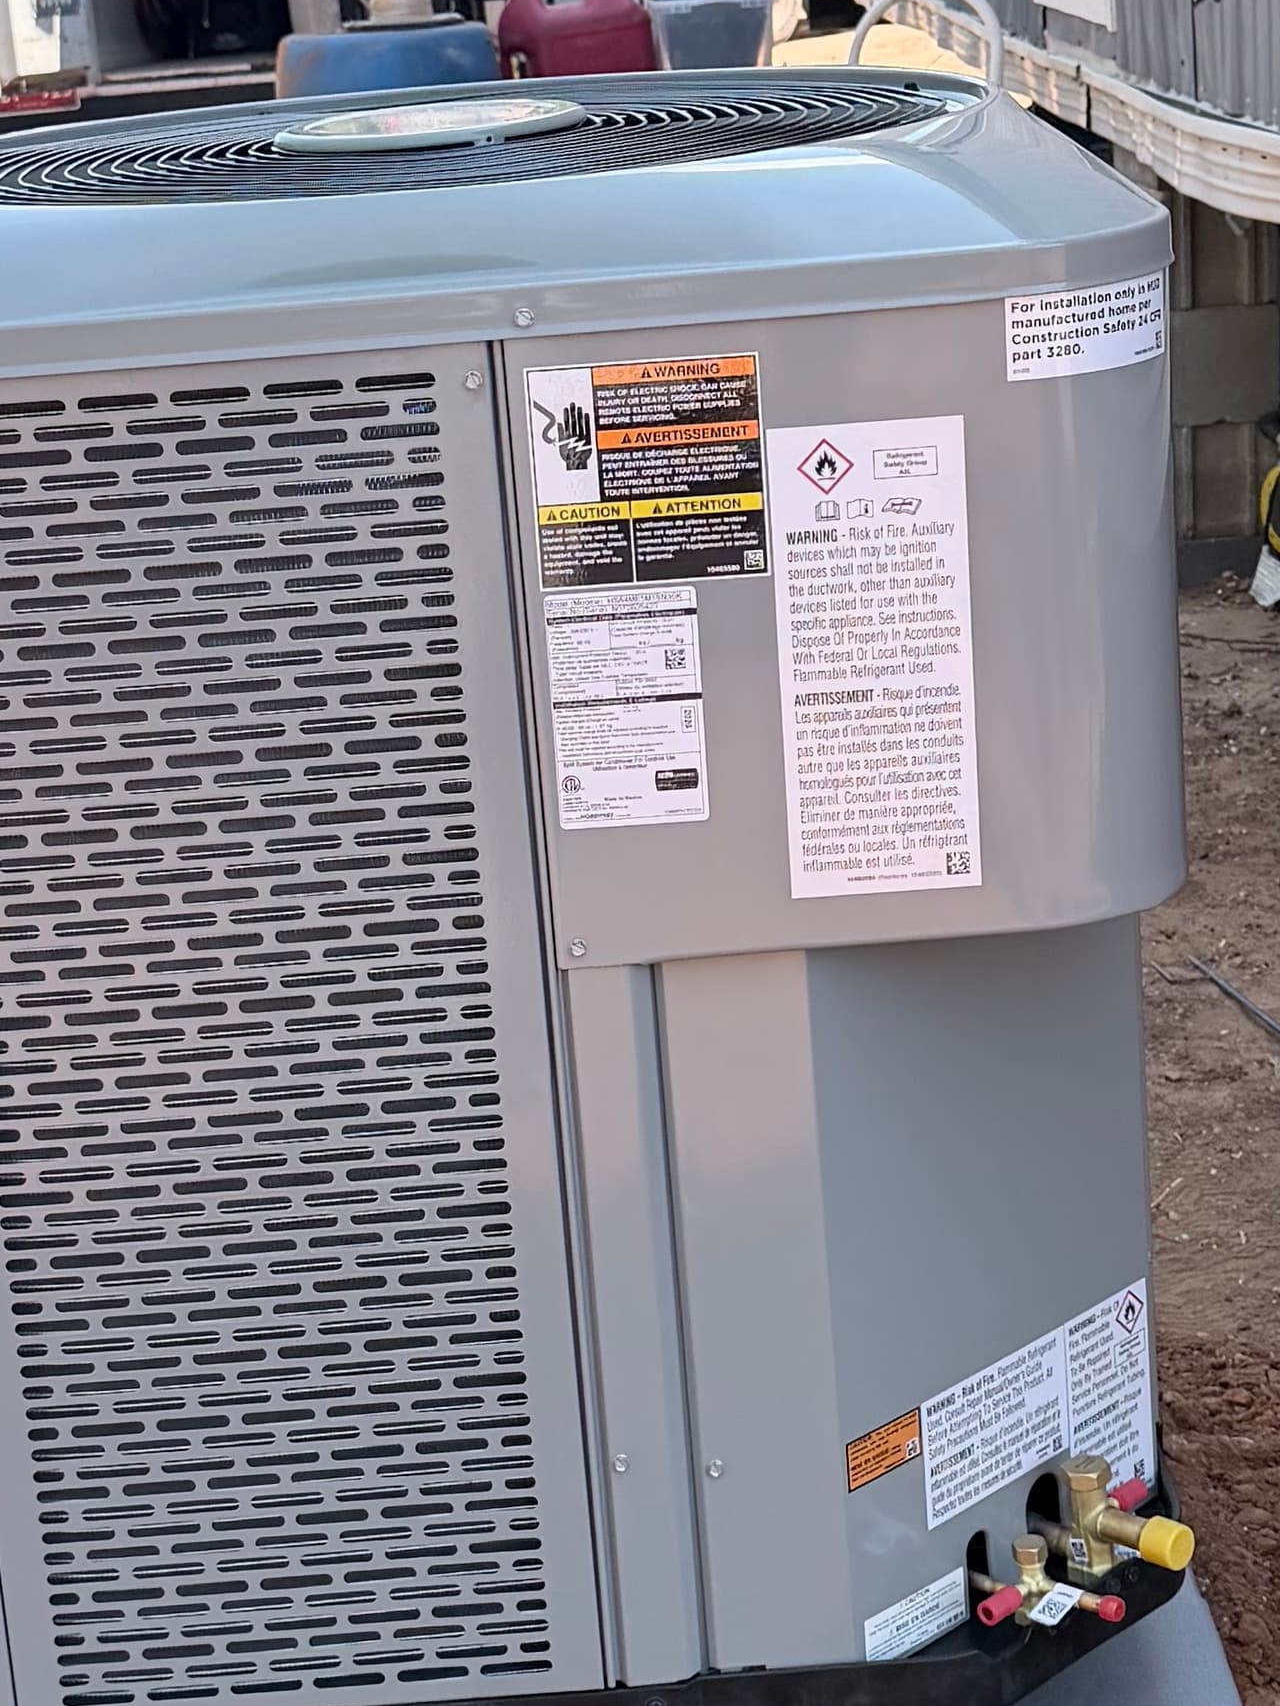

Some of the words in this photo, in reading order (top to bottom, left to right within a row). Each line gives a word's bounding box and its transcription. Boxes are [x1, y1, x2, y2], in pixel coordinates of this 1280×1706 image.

[1011, 302, 1035, 313] For
[1040, 292, 1112, 311] installation
[1115, 287, 1136, 301] only
[1012, 308, 1105, 329] manufactured
[1109, 304, 1136, 317] home
[1138, 299, 1151, 312] per
[1012, 325, 1099, 344] Construction
[1103, 318, 1136, 333] Safety
[1138, 315, 1148, 326] 24
[1013, 347, 1042, 363] part
[1047, 343, 1085, 358] 3280.
[654, 363, 720, 377] WARNING
[630, 386, 668, 395] ELECTRIC
[723, 391, 737, 399] ALL
[633, 405, 671, 414] ELECTRIC
[635, 425, 749, 443] AVERTISSEMENT
[559, 505, 621, 521] CAUTION
[666, 498, 742, 514] ATTENTION
[786, 529, 838, 544] WARNING
[849, 526, 870, 541] Risk
[874, 526, 883, 539] of
[911, 521, 955, 536] Auxiliary
[787, 548, 824, 563] devices
[827, 544, 856, 559] which
[861, 546, 881, 559] may
[885, 543, 896, 556] be
[900, 539, 937, 555] ignition
[788, 567, 827, 580] sources
[830, 563, 854, 577] shall
[857, 562, 873, 575] not
[876, 561, 888, 573] be
[891, 558, 932, 572] installed
[935, 556, 945, 569] in
[789, 584, 804, 597] the
[807, 579, 857, 596] ductwork,
[860, 579, 885, 592] other
[889, 577, 911, 589] than
[914, 573, 956, 588] auxiliary
[790, 600, 827, 614] devices
[830, 597, 856, 611] listed
[860, 597, 873, 609] for
[877, 597, 895, 608] use
[898, 593, 918, 606] with
[921, 591, 938, 604] the
[791, 616, 827, 632] specific
[829, 614, 875, 631] appliance.
[879, 611, 896, 625] See
[898, 608, 956, 623] instructions.
[792, 634, 831, 649] Dispose
[833, 632, 844, 645] Of
[847, 629, 888, 645] Properly
[891, 626, 901, 639] In
[904, 623, 961, 640] Accordance
[792, 651, 815, 665] With
[819, 648, 854, 663] Federal
[857, 647, 868, 660] Or
[872, 644, 898, 659] Local
[901, 641, 962, 660] Regulations.
[793, 666, 847, 682] Flammable
[850, 661, 906, 679] Refrigerant
[794, 689, 874, 707] AVERTISSEMENT
[883, 687, 914, 702] Risque
[795, 710, 811, 724] Les
[813, 707, 853, 725] appareils
[900, 703, 914, 718] qui
[915, 700, 962, 718] présentent
[797, 730, 808, 741] un
[811, 726, 840, 741] risque
[914, 721, 926, 732] ne
[928, 717, 962, 731] doivent
[798, 746, 814, 760] pas
[838, 739, 878, 754] installés
[880, 737, 903, 751] dans
[906, 736, 920, 749] les
[923, 734, 964, 749] conduits
[798, 761, 823, 774] autre
[826, 761, 844, 775] que
[847, 758, 861, 771] les
[864, 755, 908, 773] appareils
[911, 751, 960, 766] auxiliaires
[799, 775, 854, 791] homologués
[856, 774, 876, 789] pour
[926, 770, 947, 783] avec
[948, 768, 962, 780] cet
[844, 789, 891, 805] Consulter
[895, 787, 909, 800] les
[912, 783, 961, 799] directives.
[844, 808, 856, 821] de
[859, 804, 898, 819] manière
[801, 824, 870, 840] conformément
[872, 824, 890, 836] aux
[802, 840, 845, 857] fédérales
[848, 840, 861, 852] ou
[902, 836, 916, 850] Un
[803, 856, 863, 873] inflammable
[866, 854, 881, 869] est
